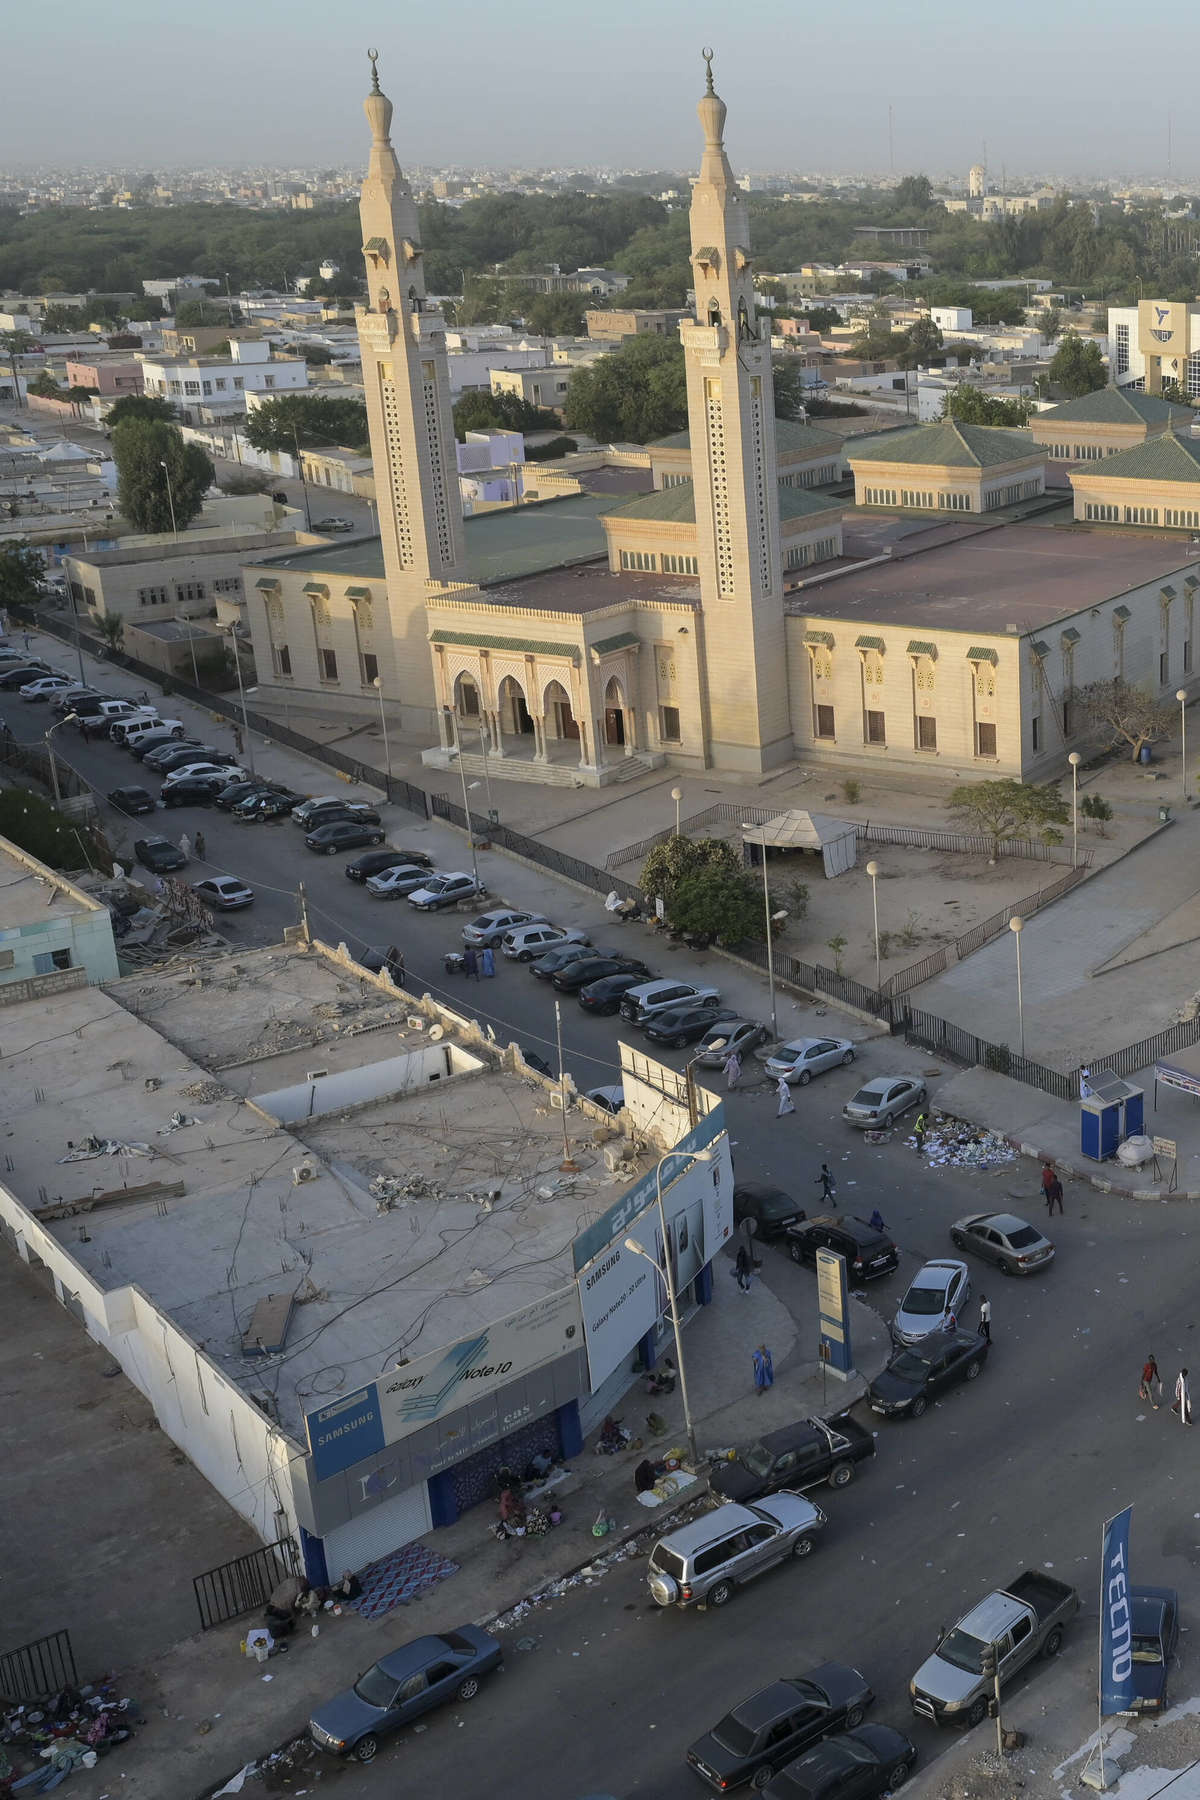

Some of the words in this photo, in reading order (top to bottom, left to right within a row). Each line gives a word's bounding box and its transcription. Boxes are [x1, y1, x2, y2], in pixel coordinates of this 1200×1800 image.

[586, 1250, 621, 1291] SAMSUNG
[592, 1311, 609, 1332] Galaxy
[385, 1374, 425, 1395] Galaxy
[317, 1410, 375, 1447] SAMSUNG
[1108, 1541, 1133, 1683] TECNO
